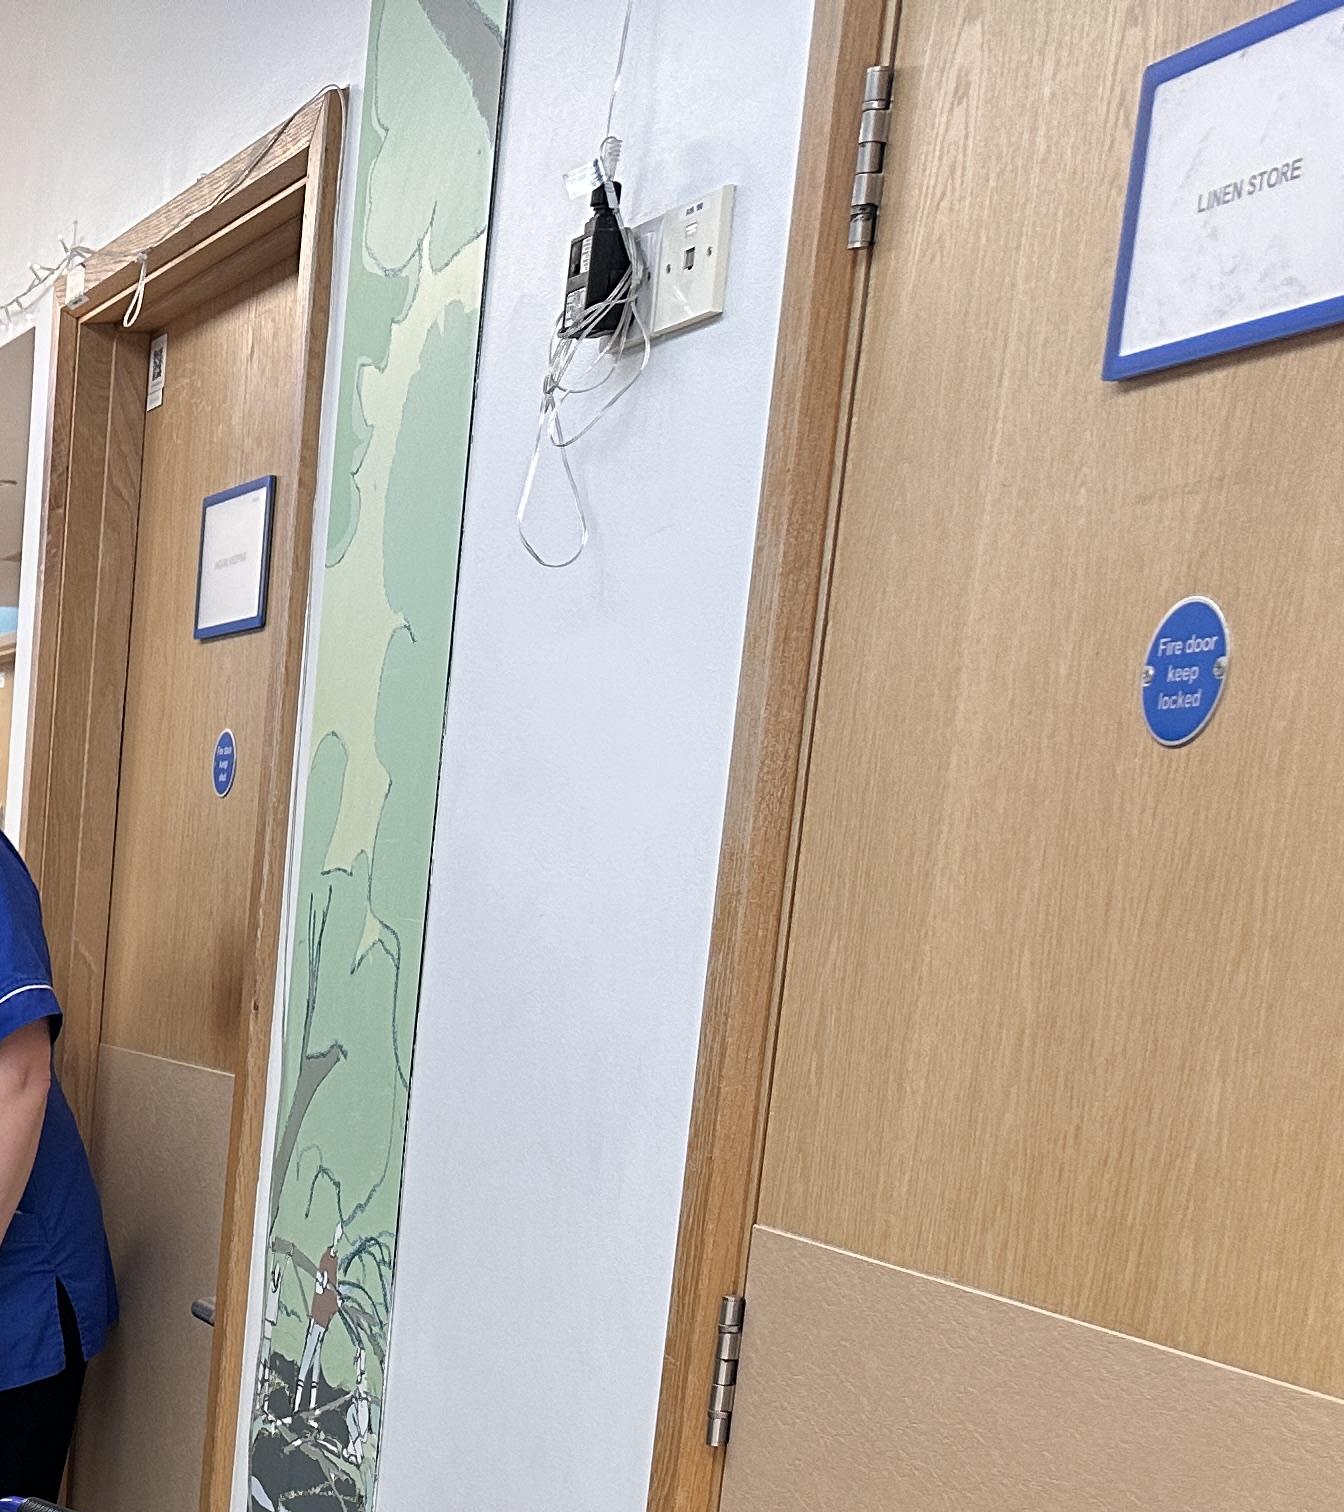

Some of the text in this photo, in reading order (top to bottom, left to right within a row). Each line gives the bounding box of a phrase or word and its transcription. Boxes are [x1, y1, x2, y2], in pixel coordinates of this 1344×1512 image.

[1197, 157, 1304, 213] LINEN STORE
[1158, 634, 1219, 657] Fire door
[1166, 665, 1200, 685] keep
[1158, 688, 1202, 710] locked
